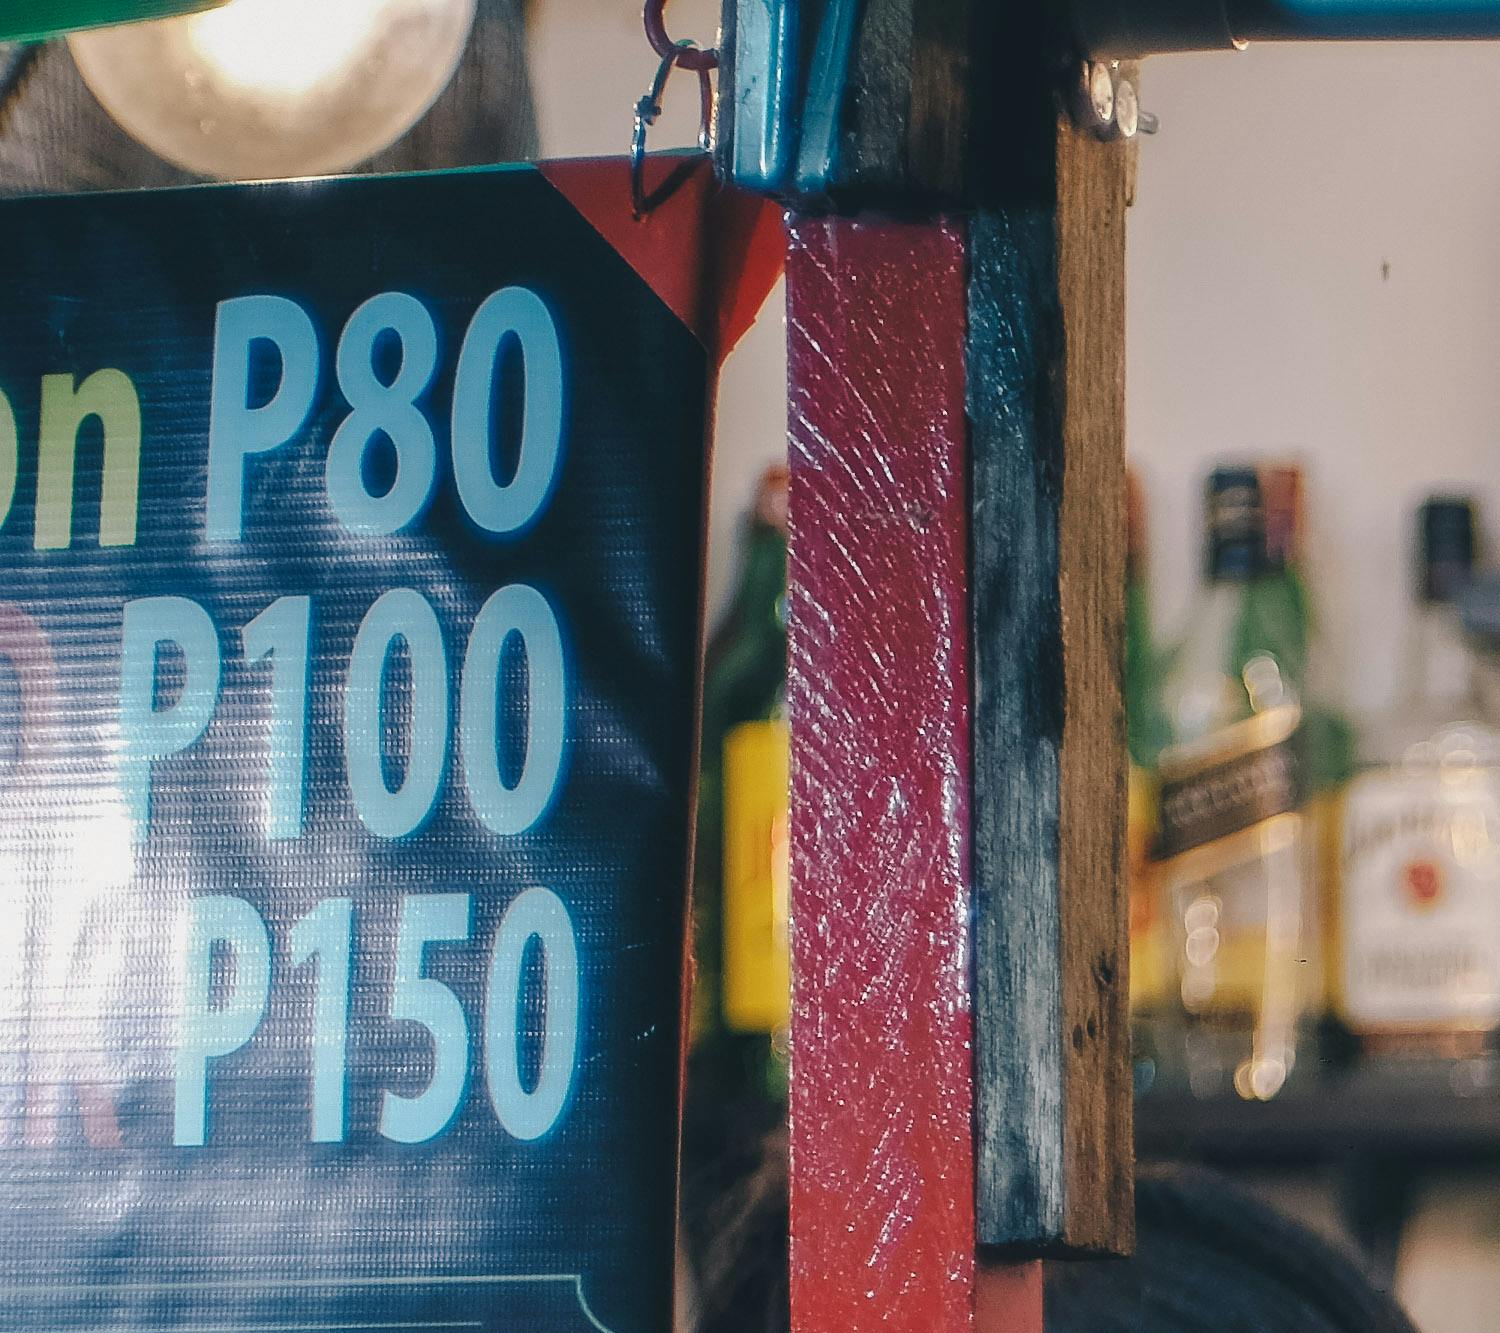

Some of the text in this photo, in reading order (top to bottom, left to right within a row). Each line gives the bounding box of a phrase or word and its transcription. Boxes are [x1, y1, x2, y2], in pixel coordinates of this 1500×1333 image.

[0, 286, 564, 553] n P80
[118, 583, 567, 845] P100
[171, 888, 581, 1148] P150
